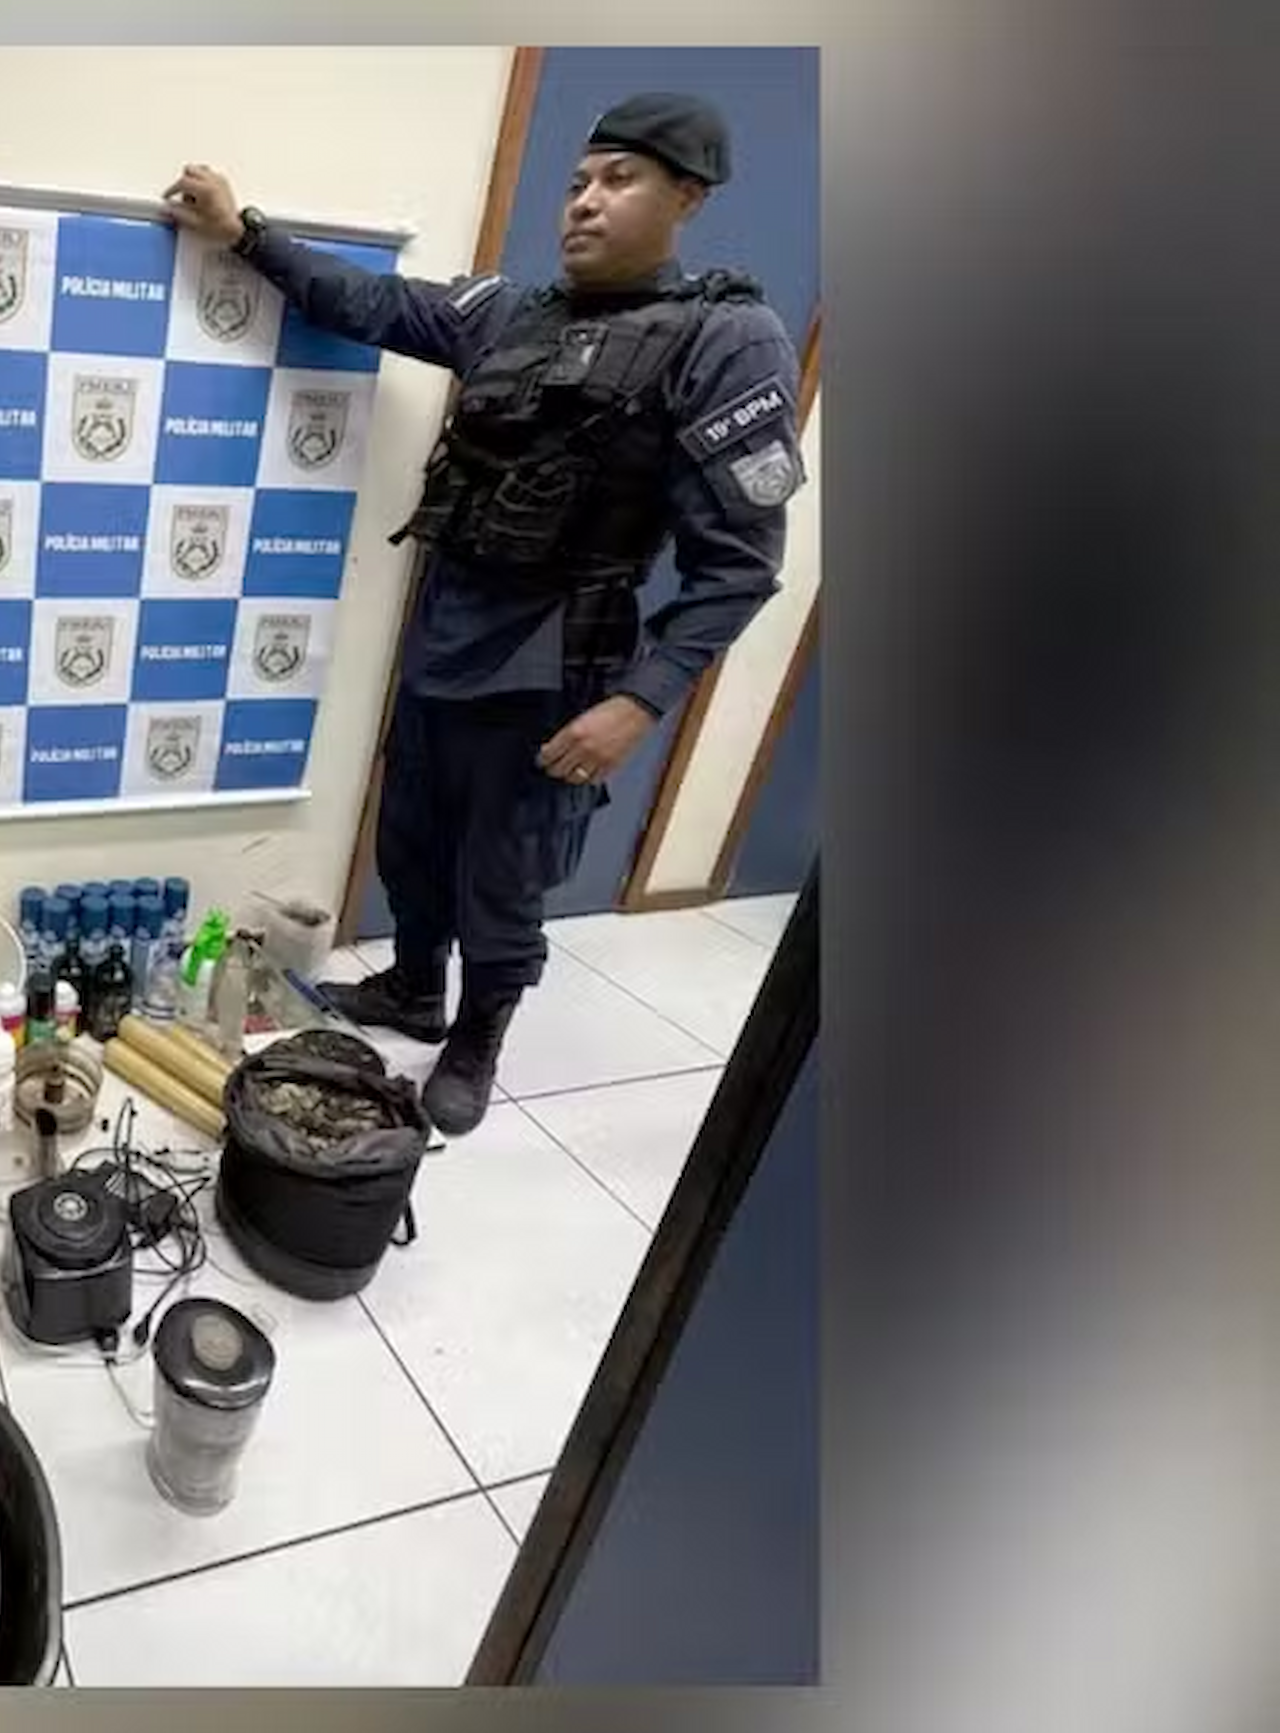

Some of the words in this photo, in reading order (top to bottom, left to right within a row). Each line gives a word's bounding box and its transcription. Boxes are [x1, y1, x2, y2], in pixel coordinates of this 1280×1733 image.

[62, 275, 111, 298] POLÍCIA
[112, 280, 165, 301] MILITAR
[733, 390, 784, 427] BPM
